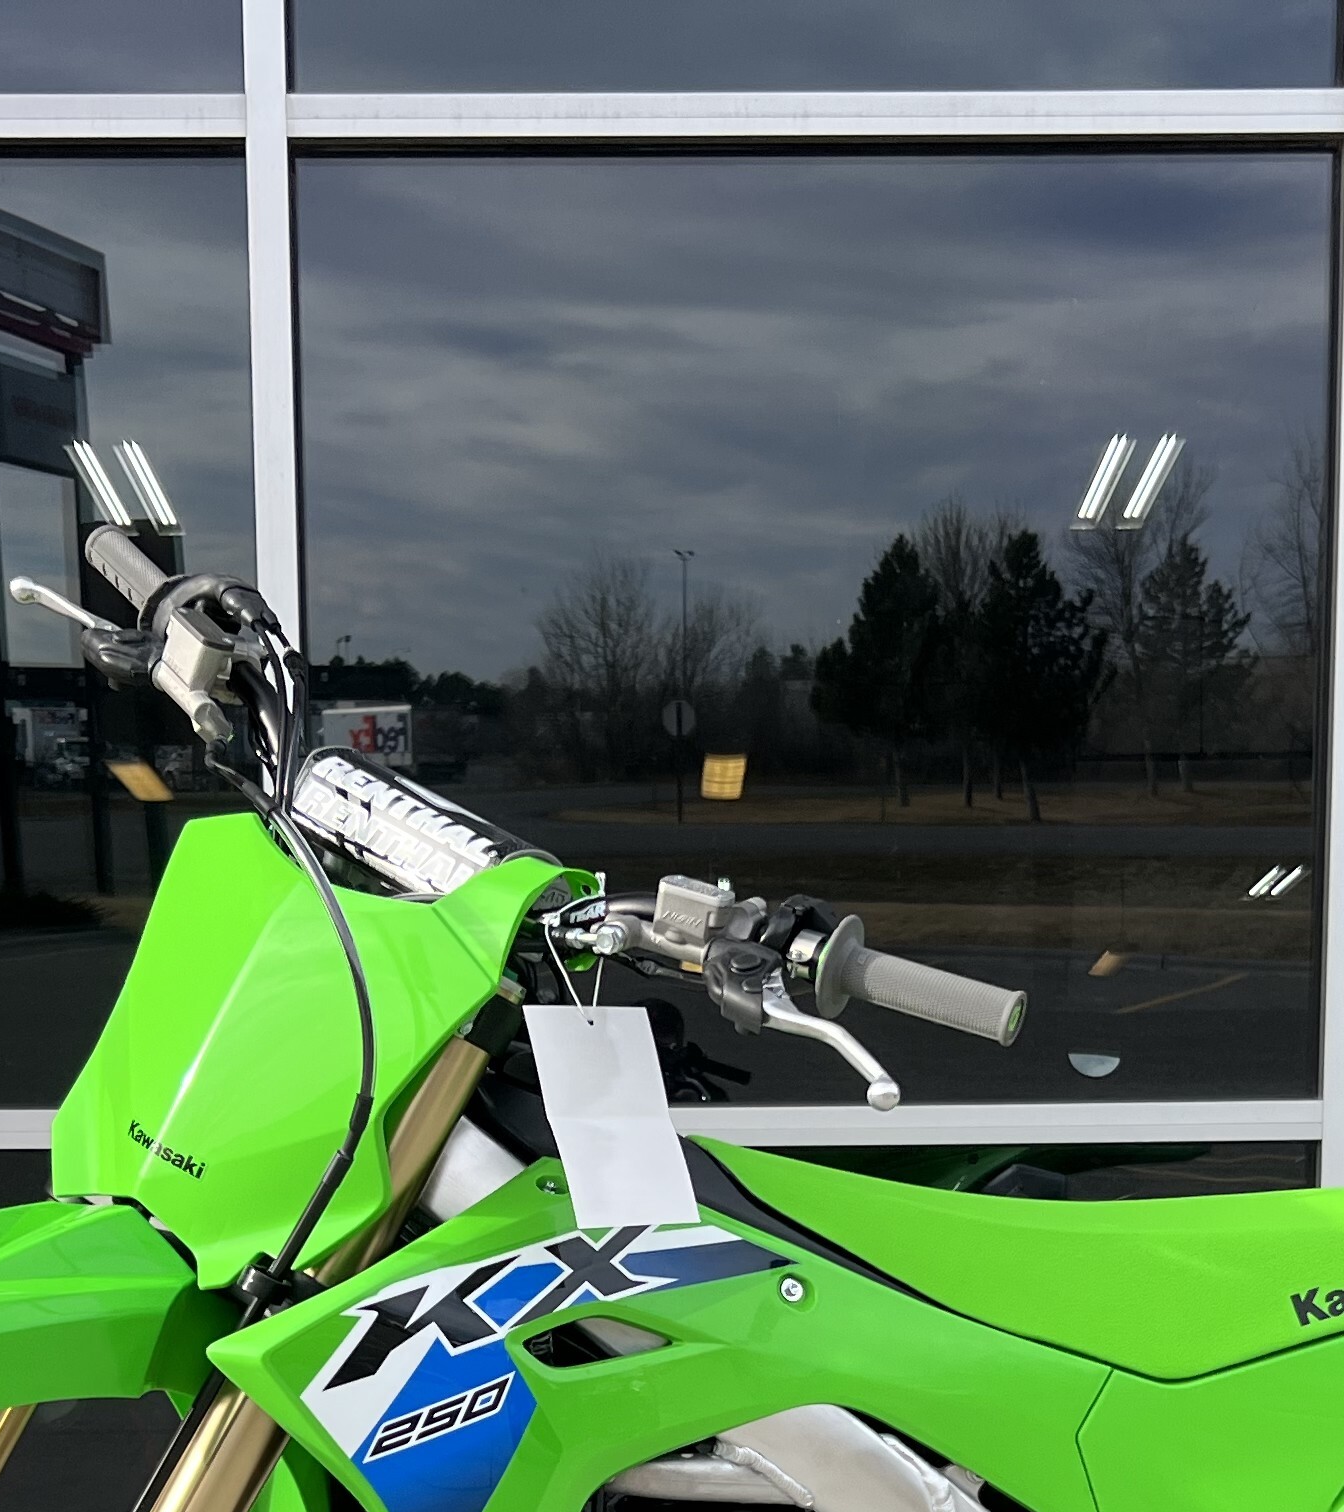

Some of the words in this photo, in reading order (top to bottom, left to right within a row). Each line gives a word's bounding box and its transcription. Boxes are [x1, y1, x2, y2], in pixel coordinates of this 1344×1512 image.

[311, 756, 496, 867] RENTHAL
[127, 1119, 206, 1179] Kawasaki
[323, 1224, 648, 1391] KX
[367, 1376, 511, 1459] 250
